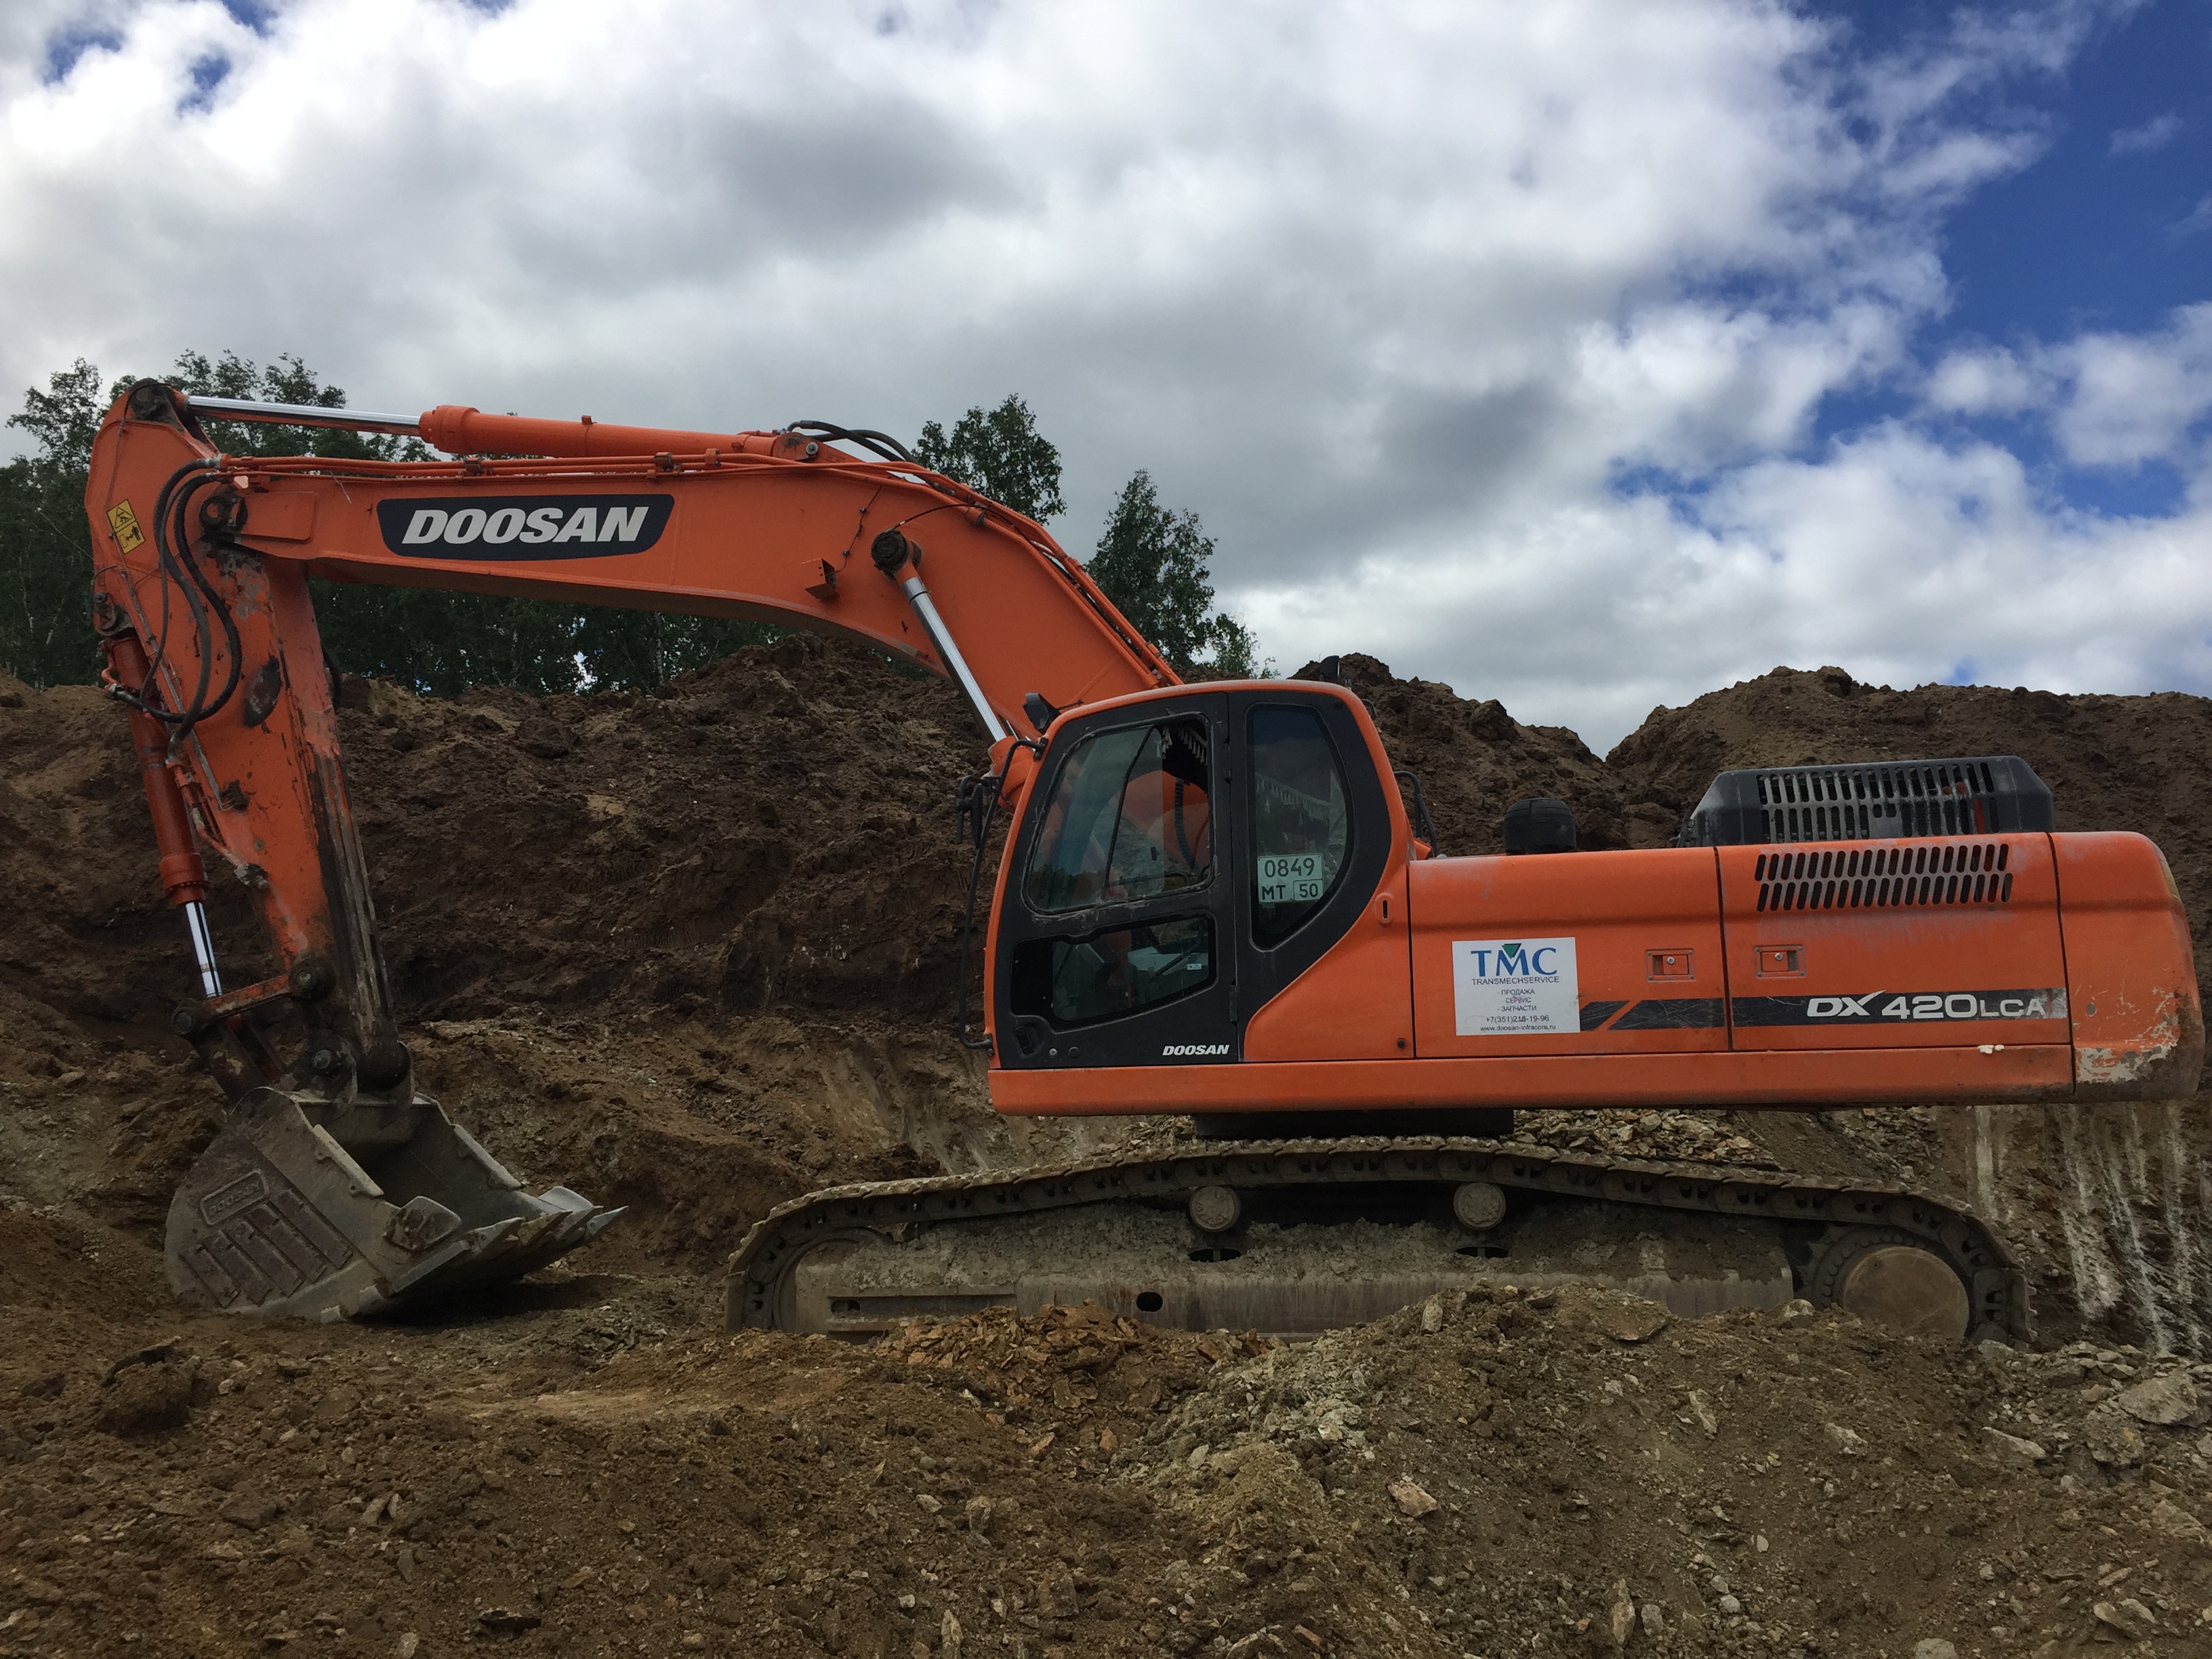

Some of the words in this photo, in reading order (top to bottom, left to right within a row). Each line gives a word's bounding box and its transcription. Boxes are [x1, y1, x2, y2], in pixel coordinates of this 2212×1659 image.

[402, 506, 649, 544] DOOSAN
[1265, 857, 1315, 878] 0849
[1299, 883, 1319, 898] 50
[1471, 976, 1560, 985] TRANSMECHSERVICE
[1807, 989, 1886, 1017] DX
[1162, 1044, 1229, 1056] DOOSAN
